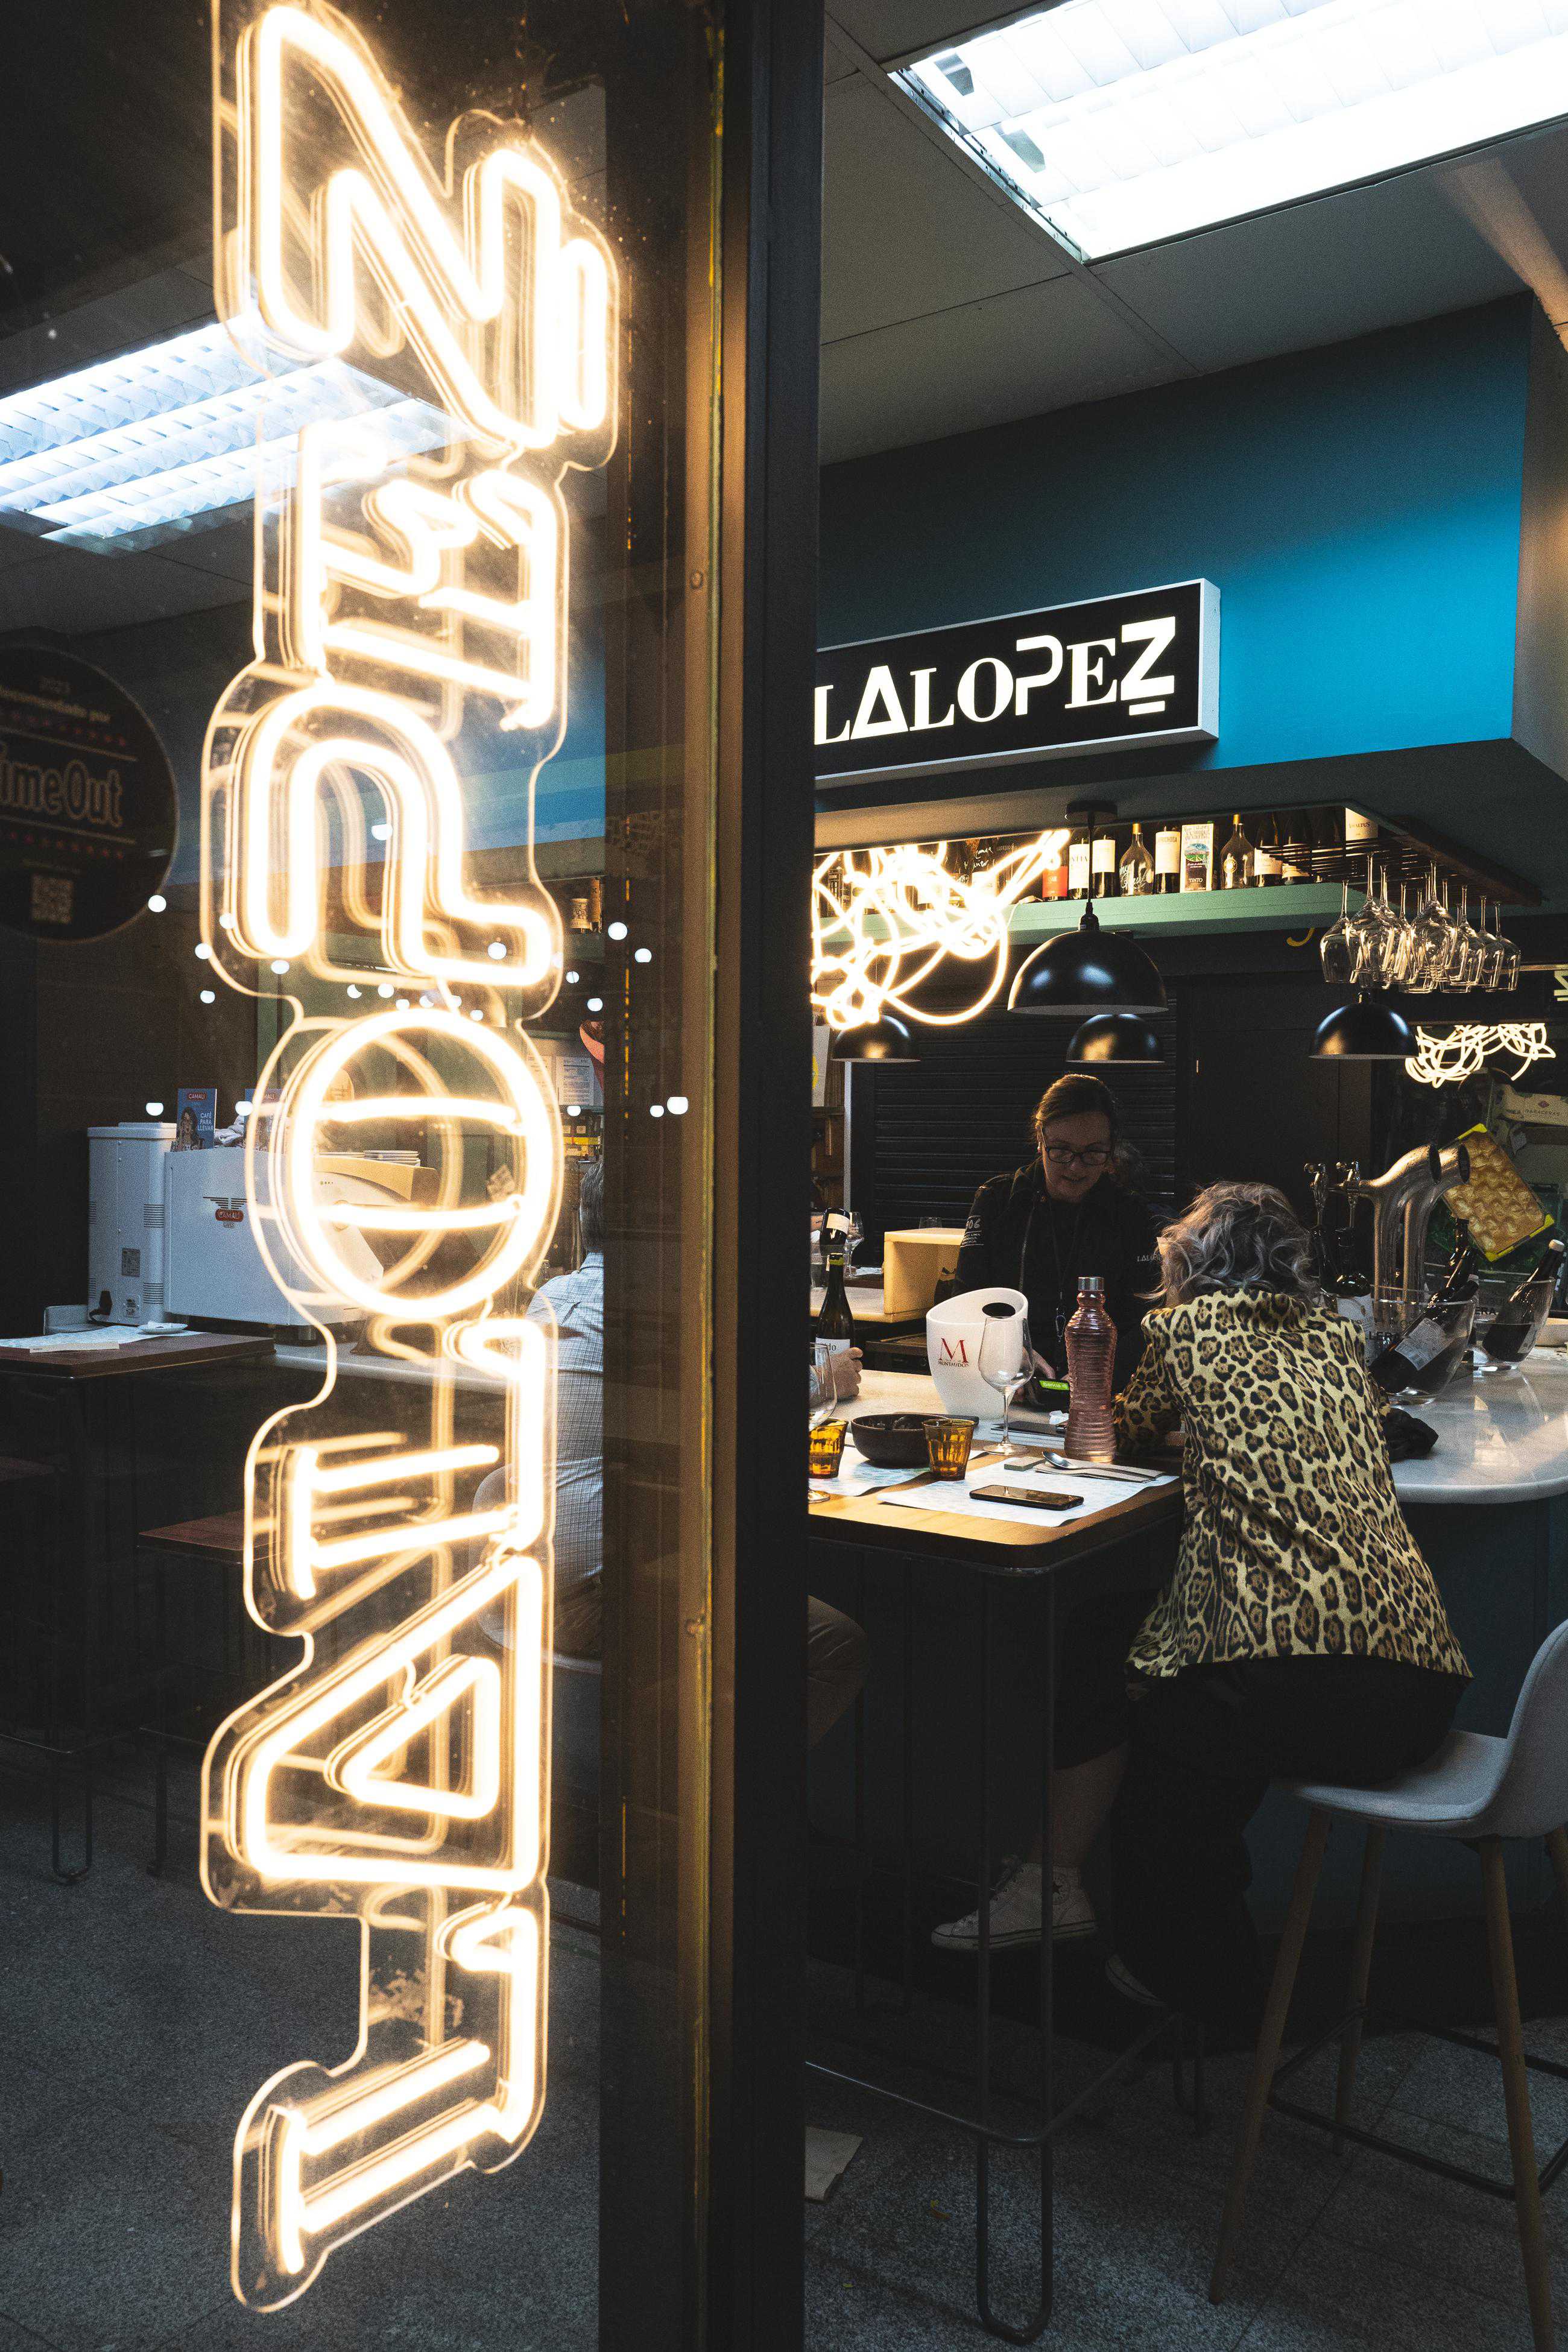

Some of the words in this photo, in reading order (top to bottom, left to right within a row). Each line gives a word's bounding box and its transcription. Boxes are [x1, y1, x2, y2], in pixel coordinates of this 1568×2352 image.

[814, 616, 1175, 745] LALOPEZ
[0, 741, 123, 827] imeOut
[238, 2, 609, 2275] LALOPEZ
